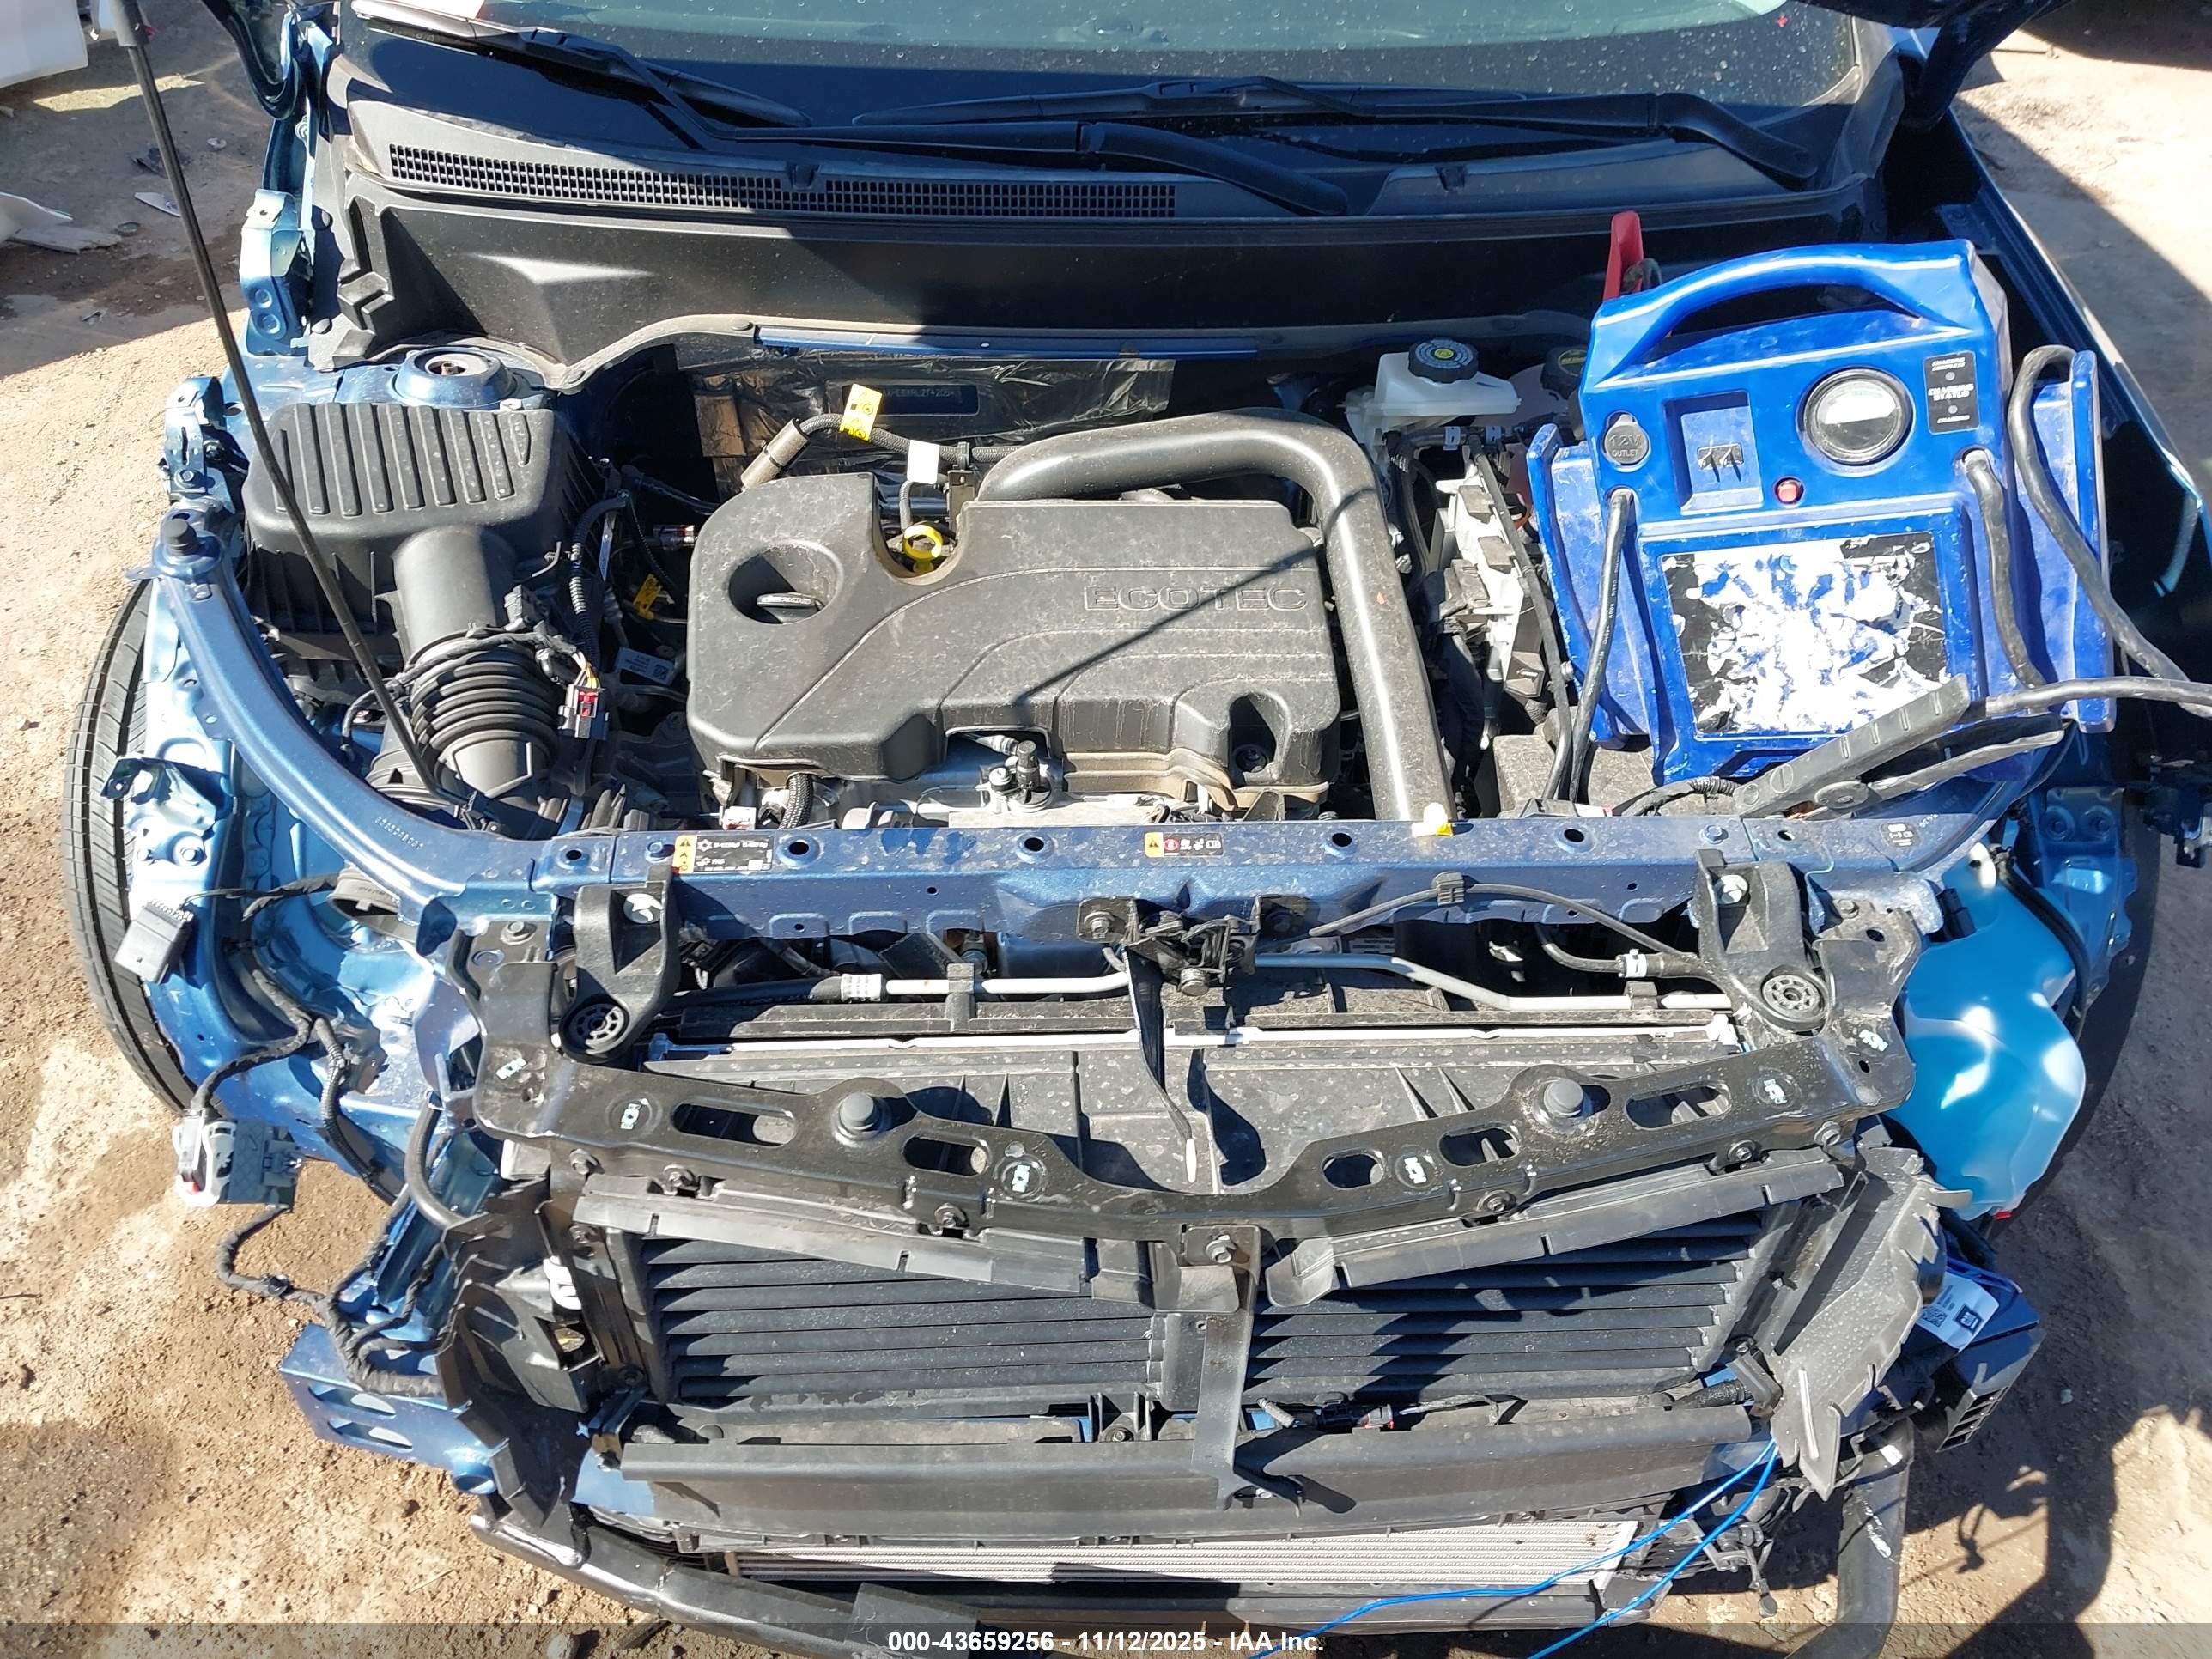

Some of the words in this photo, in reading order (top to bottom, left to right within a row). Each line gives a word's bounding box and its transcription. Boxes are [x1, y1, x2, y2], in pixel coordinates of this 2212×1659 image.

[1608, 434, 1640, 447] 12V
[1611, 448, 1639, 458] OUTLET
[1084, 586, 1308, 612] ECOTEC
